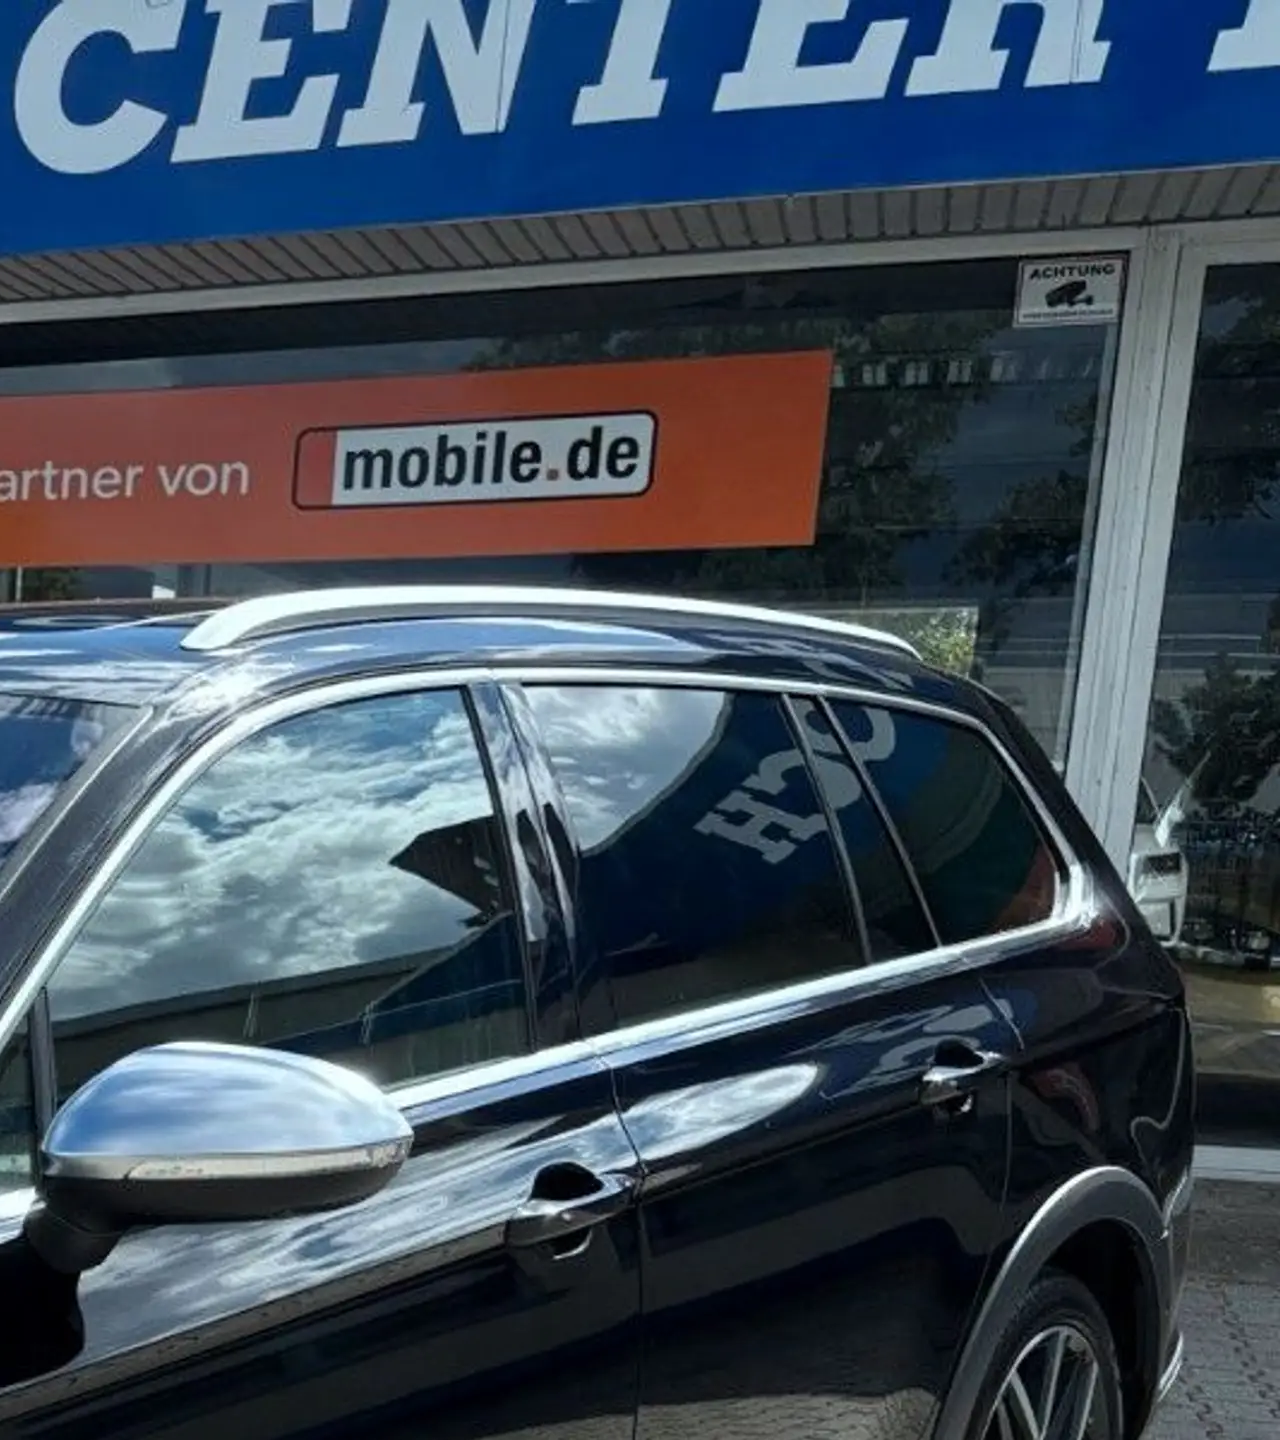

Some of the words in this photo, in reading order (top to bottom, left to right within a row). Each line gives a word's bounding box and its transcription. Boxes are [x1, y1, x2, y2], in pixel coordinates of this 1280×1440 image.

[1029, 263, 1115, 280] ACHTUNG
[157, 460, 249, 498] von
[344, 426, 640, 491] mobile.de
